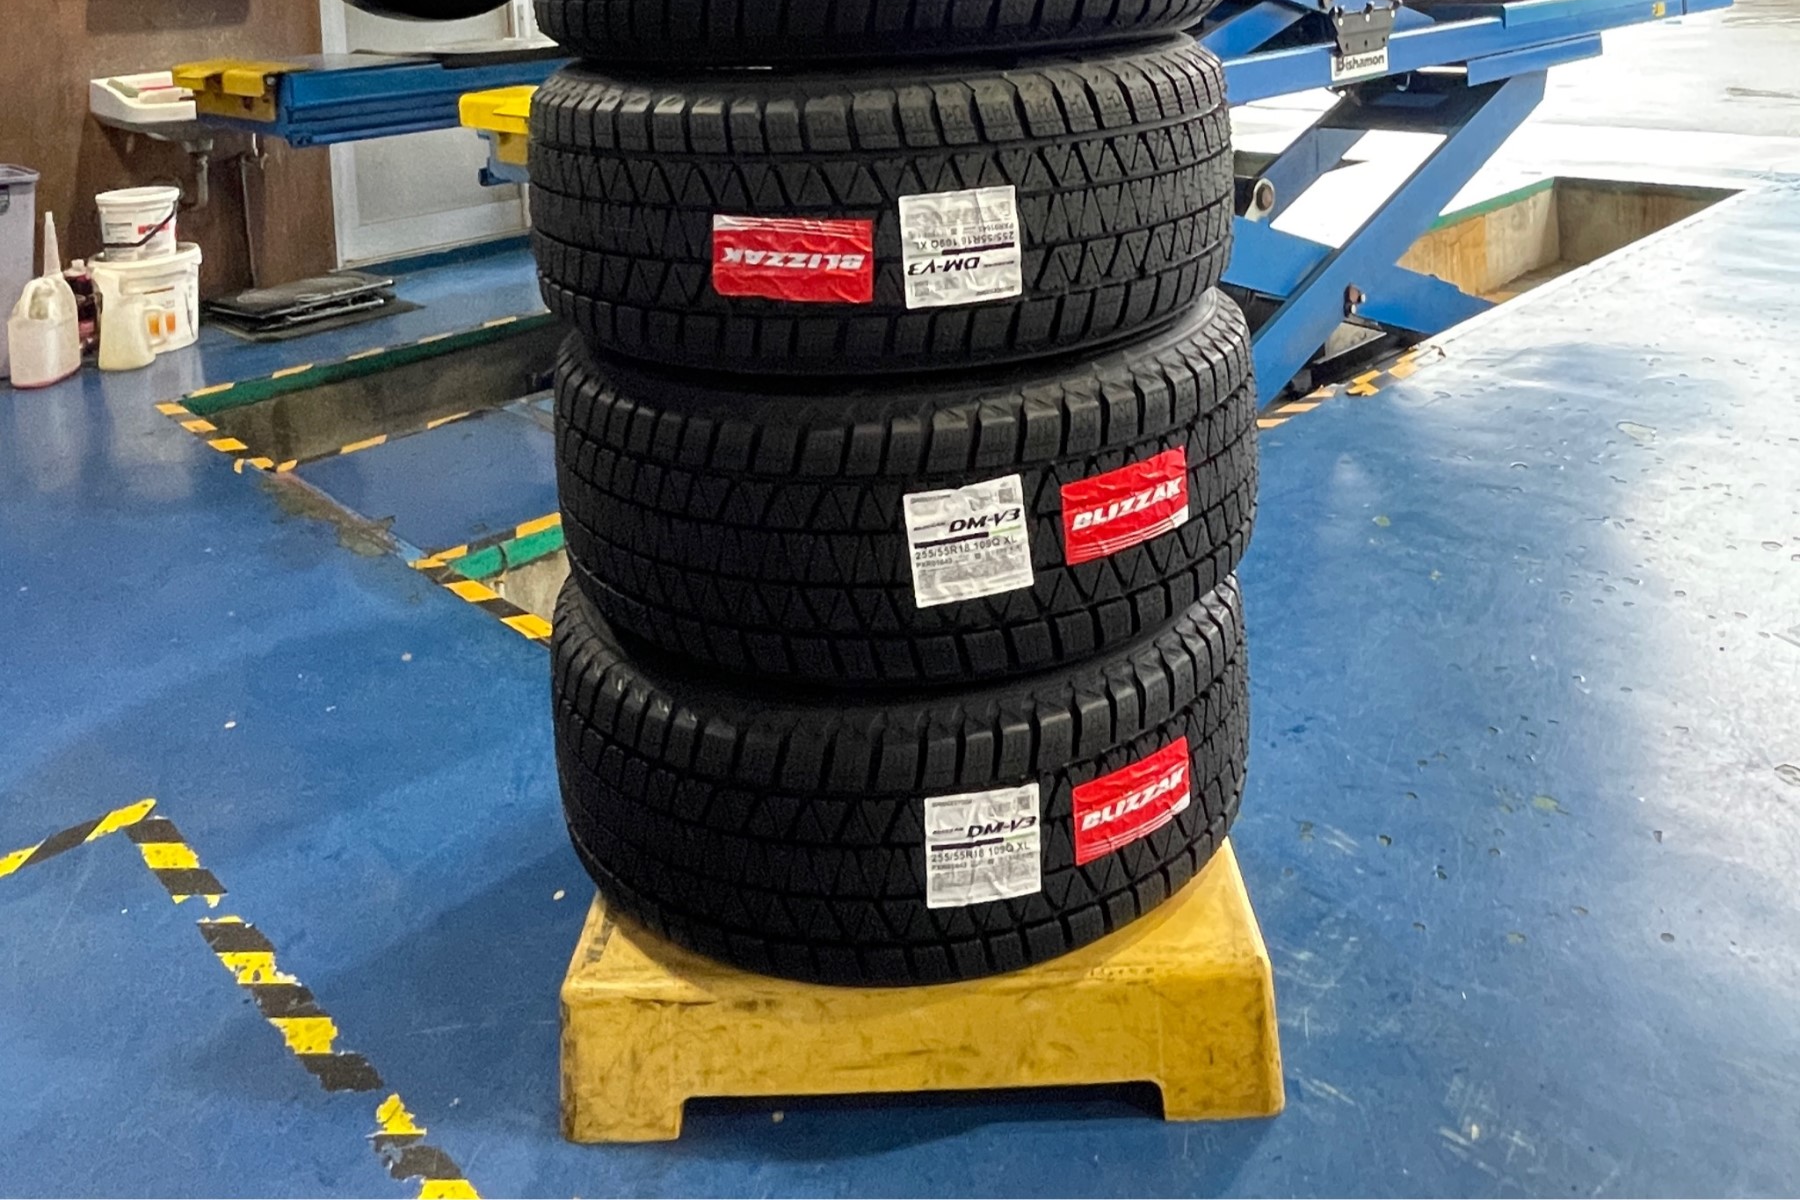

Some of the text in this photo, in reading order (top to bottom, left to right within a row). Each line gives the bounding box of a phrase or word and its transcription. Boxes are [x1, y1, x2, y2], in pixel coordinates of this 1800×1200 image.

[1334, 54, 1385, 73] Bishamon
[912, 241, 927, 250] XL
[721, 247, 866, 270] BLIZZAK
[907, 256, 981, 276] DM-V3
[1071, 476, 1183, 532] BLIZZAK
[949, 507, 1021, 533] DM-V3
[915, 543, 971, 560] 255/55R18
[1003, 537, 1018, 545] XL
[1081, 767, 1186, 831] BLIZZAK
[966, 815, 1037, 838] DM-V3
[1016, 842, 1031, 851] XL
